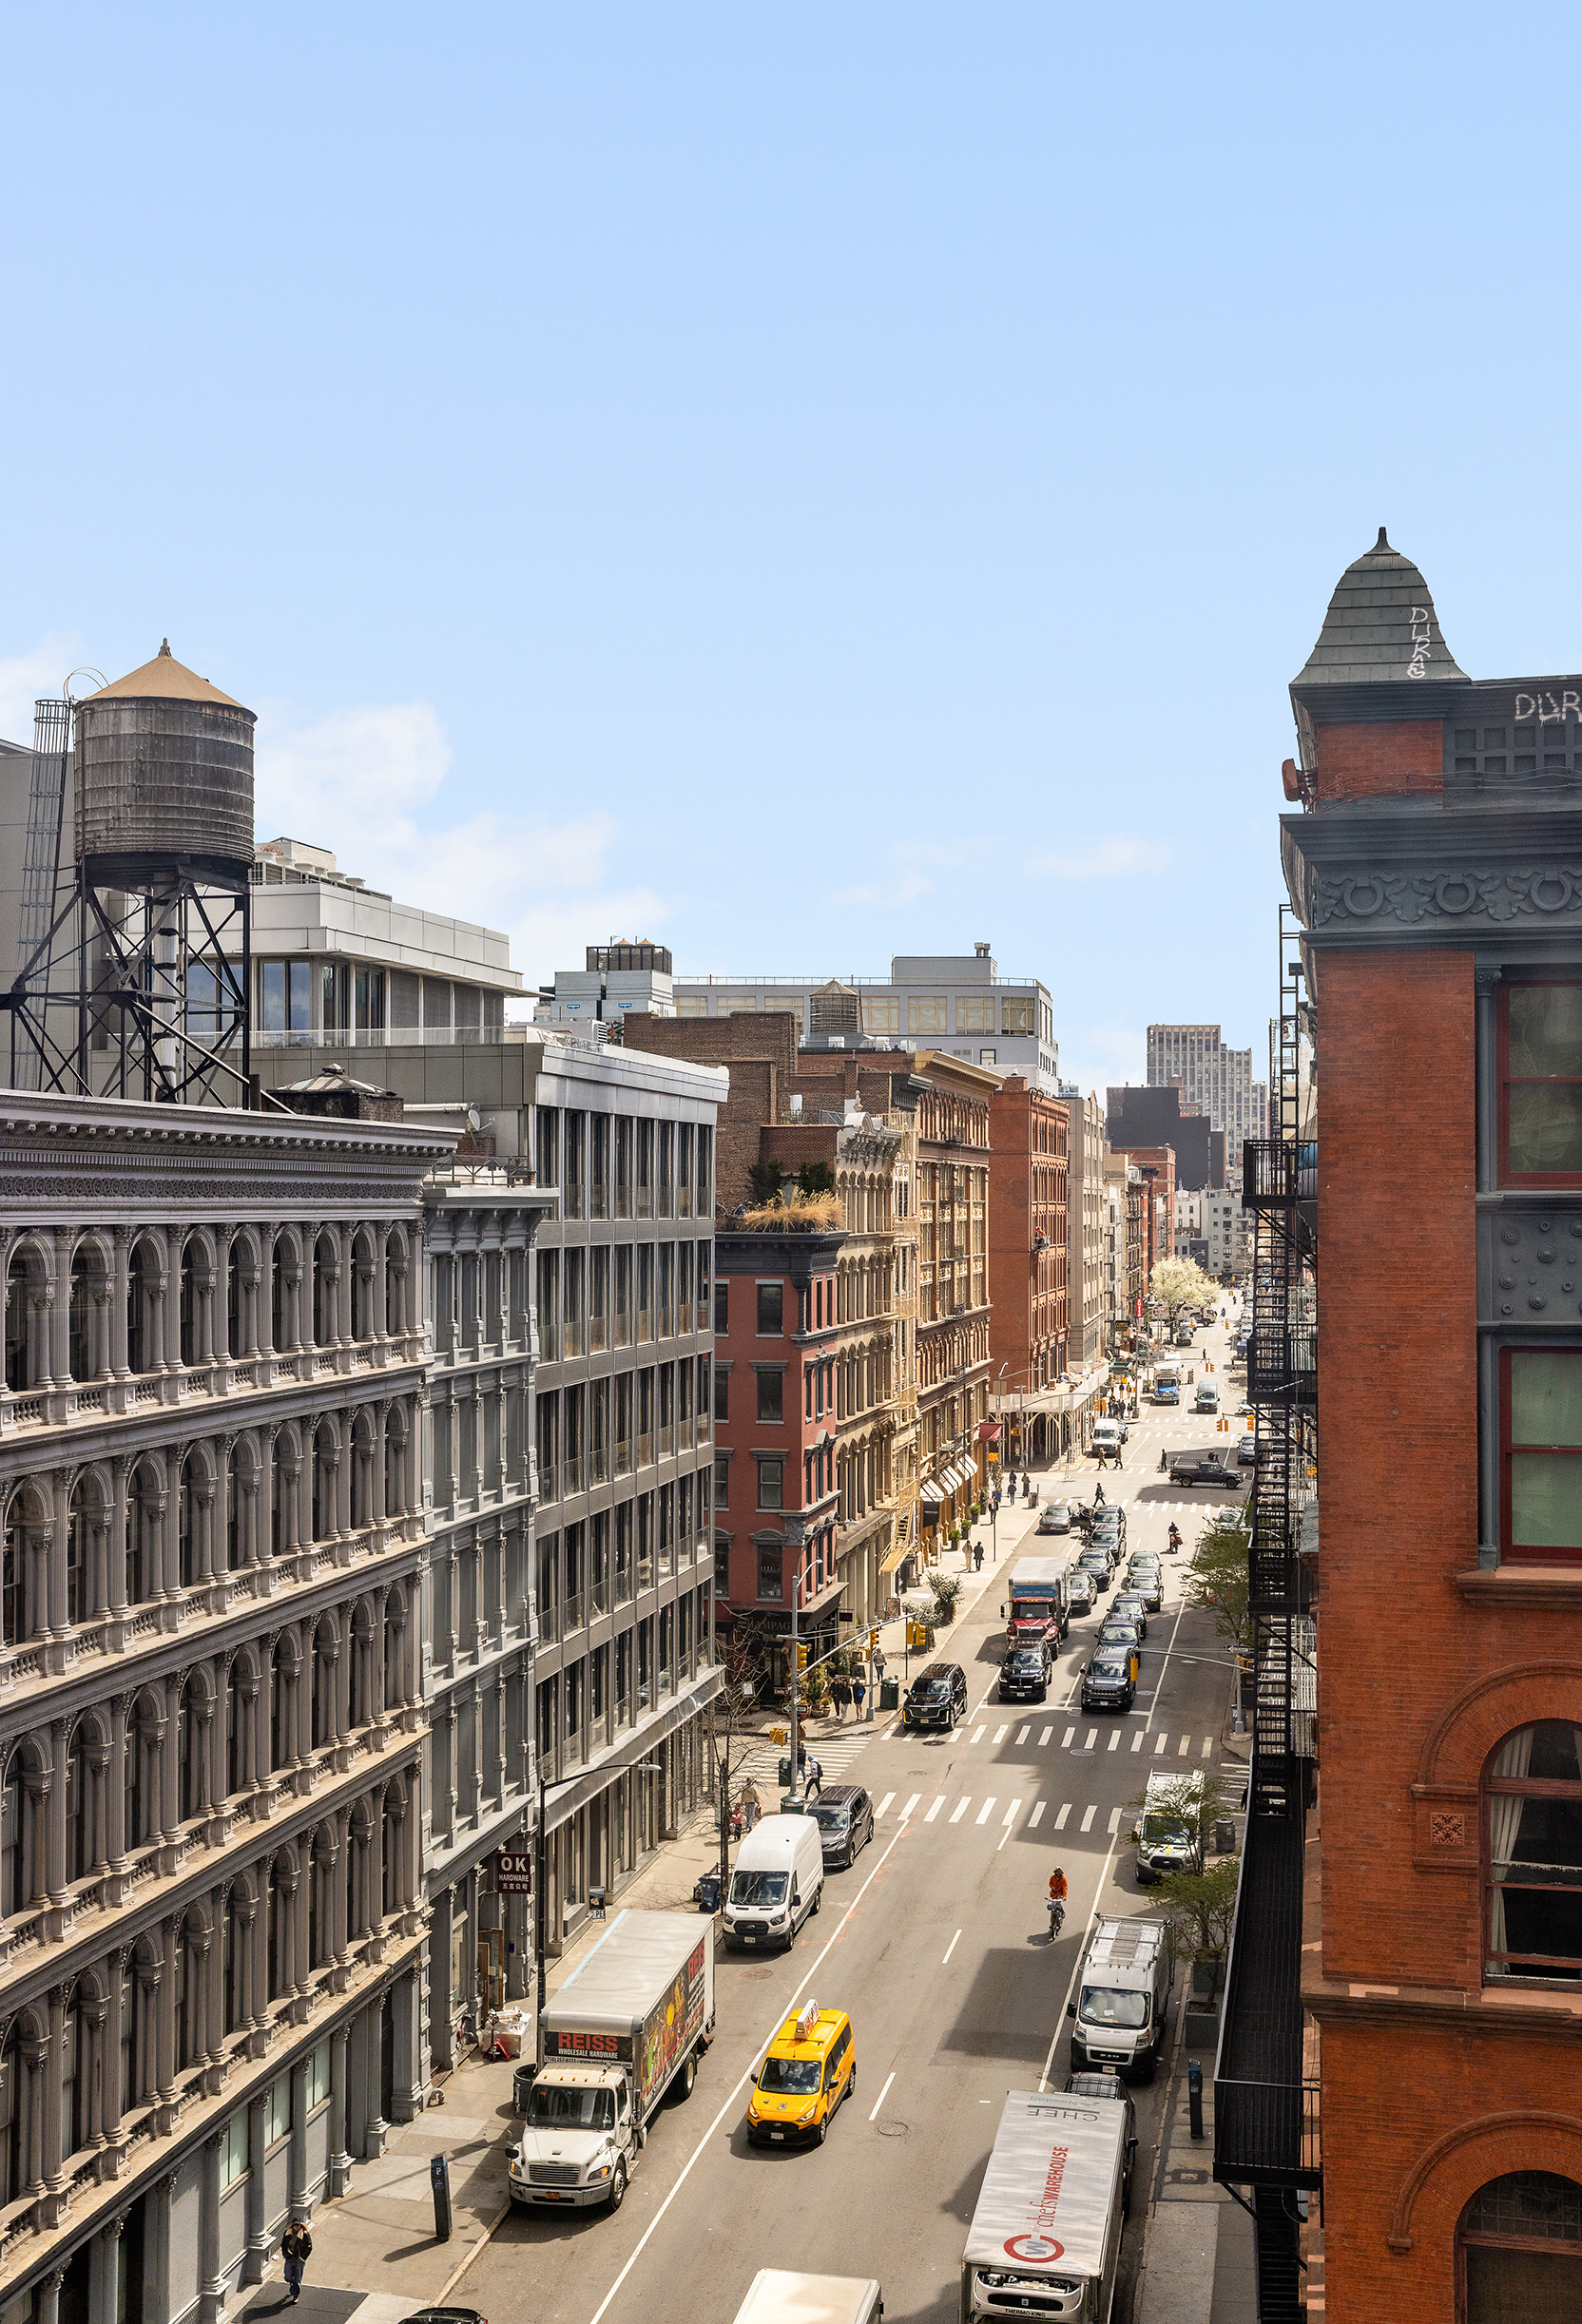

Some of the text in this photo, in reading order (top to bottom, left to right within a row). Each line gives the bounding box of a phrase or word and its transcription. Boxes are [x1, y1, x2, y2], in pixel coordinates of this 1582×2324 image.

[501, 1856, 527, 1873] OK
[498, 1873, 530, 1882] HARDWARE
[558, 2032, 618, 2052] REISS
[558, 2047, 618, 2059] WHOLESALE HARDWARE
[1027, 2108, 1098, 2122] CHEF
[1004, 2308, 1031, 2316] THERMO
